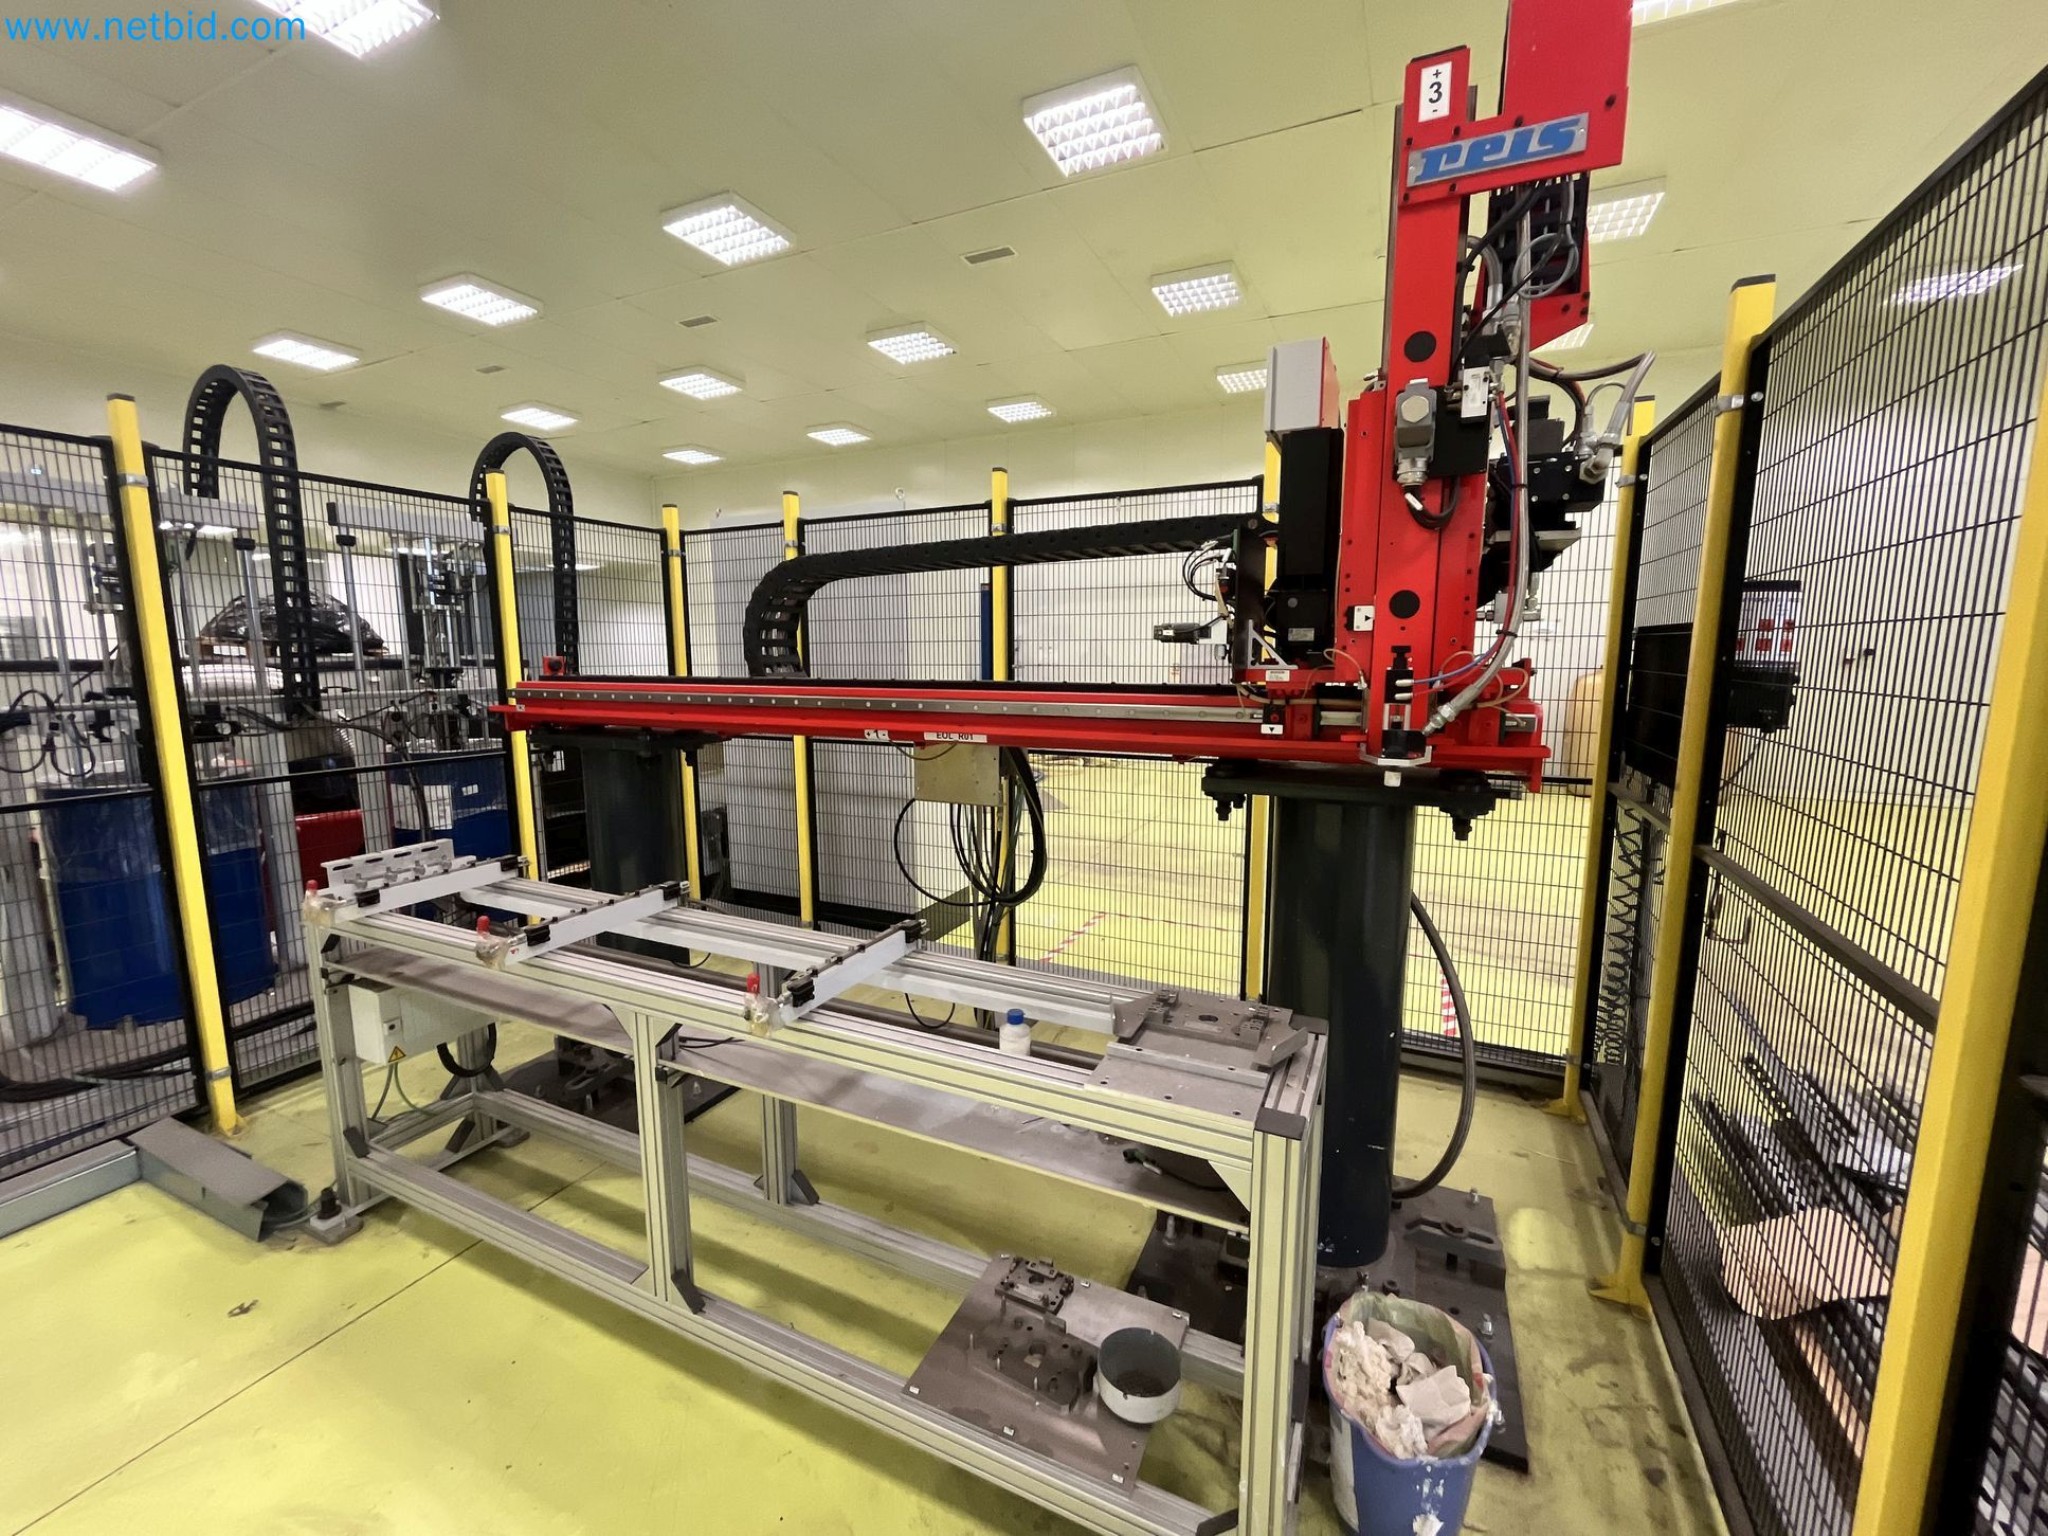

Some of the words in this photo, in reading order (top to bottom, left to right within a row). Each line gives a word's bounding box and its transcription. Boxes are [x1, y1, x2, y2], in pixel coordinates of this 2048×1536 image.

[1429, 81, 1442, 104] 3
[1414, 118, 1581, 184] reis
[936, 731, 953, 740] EOL
